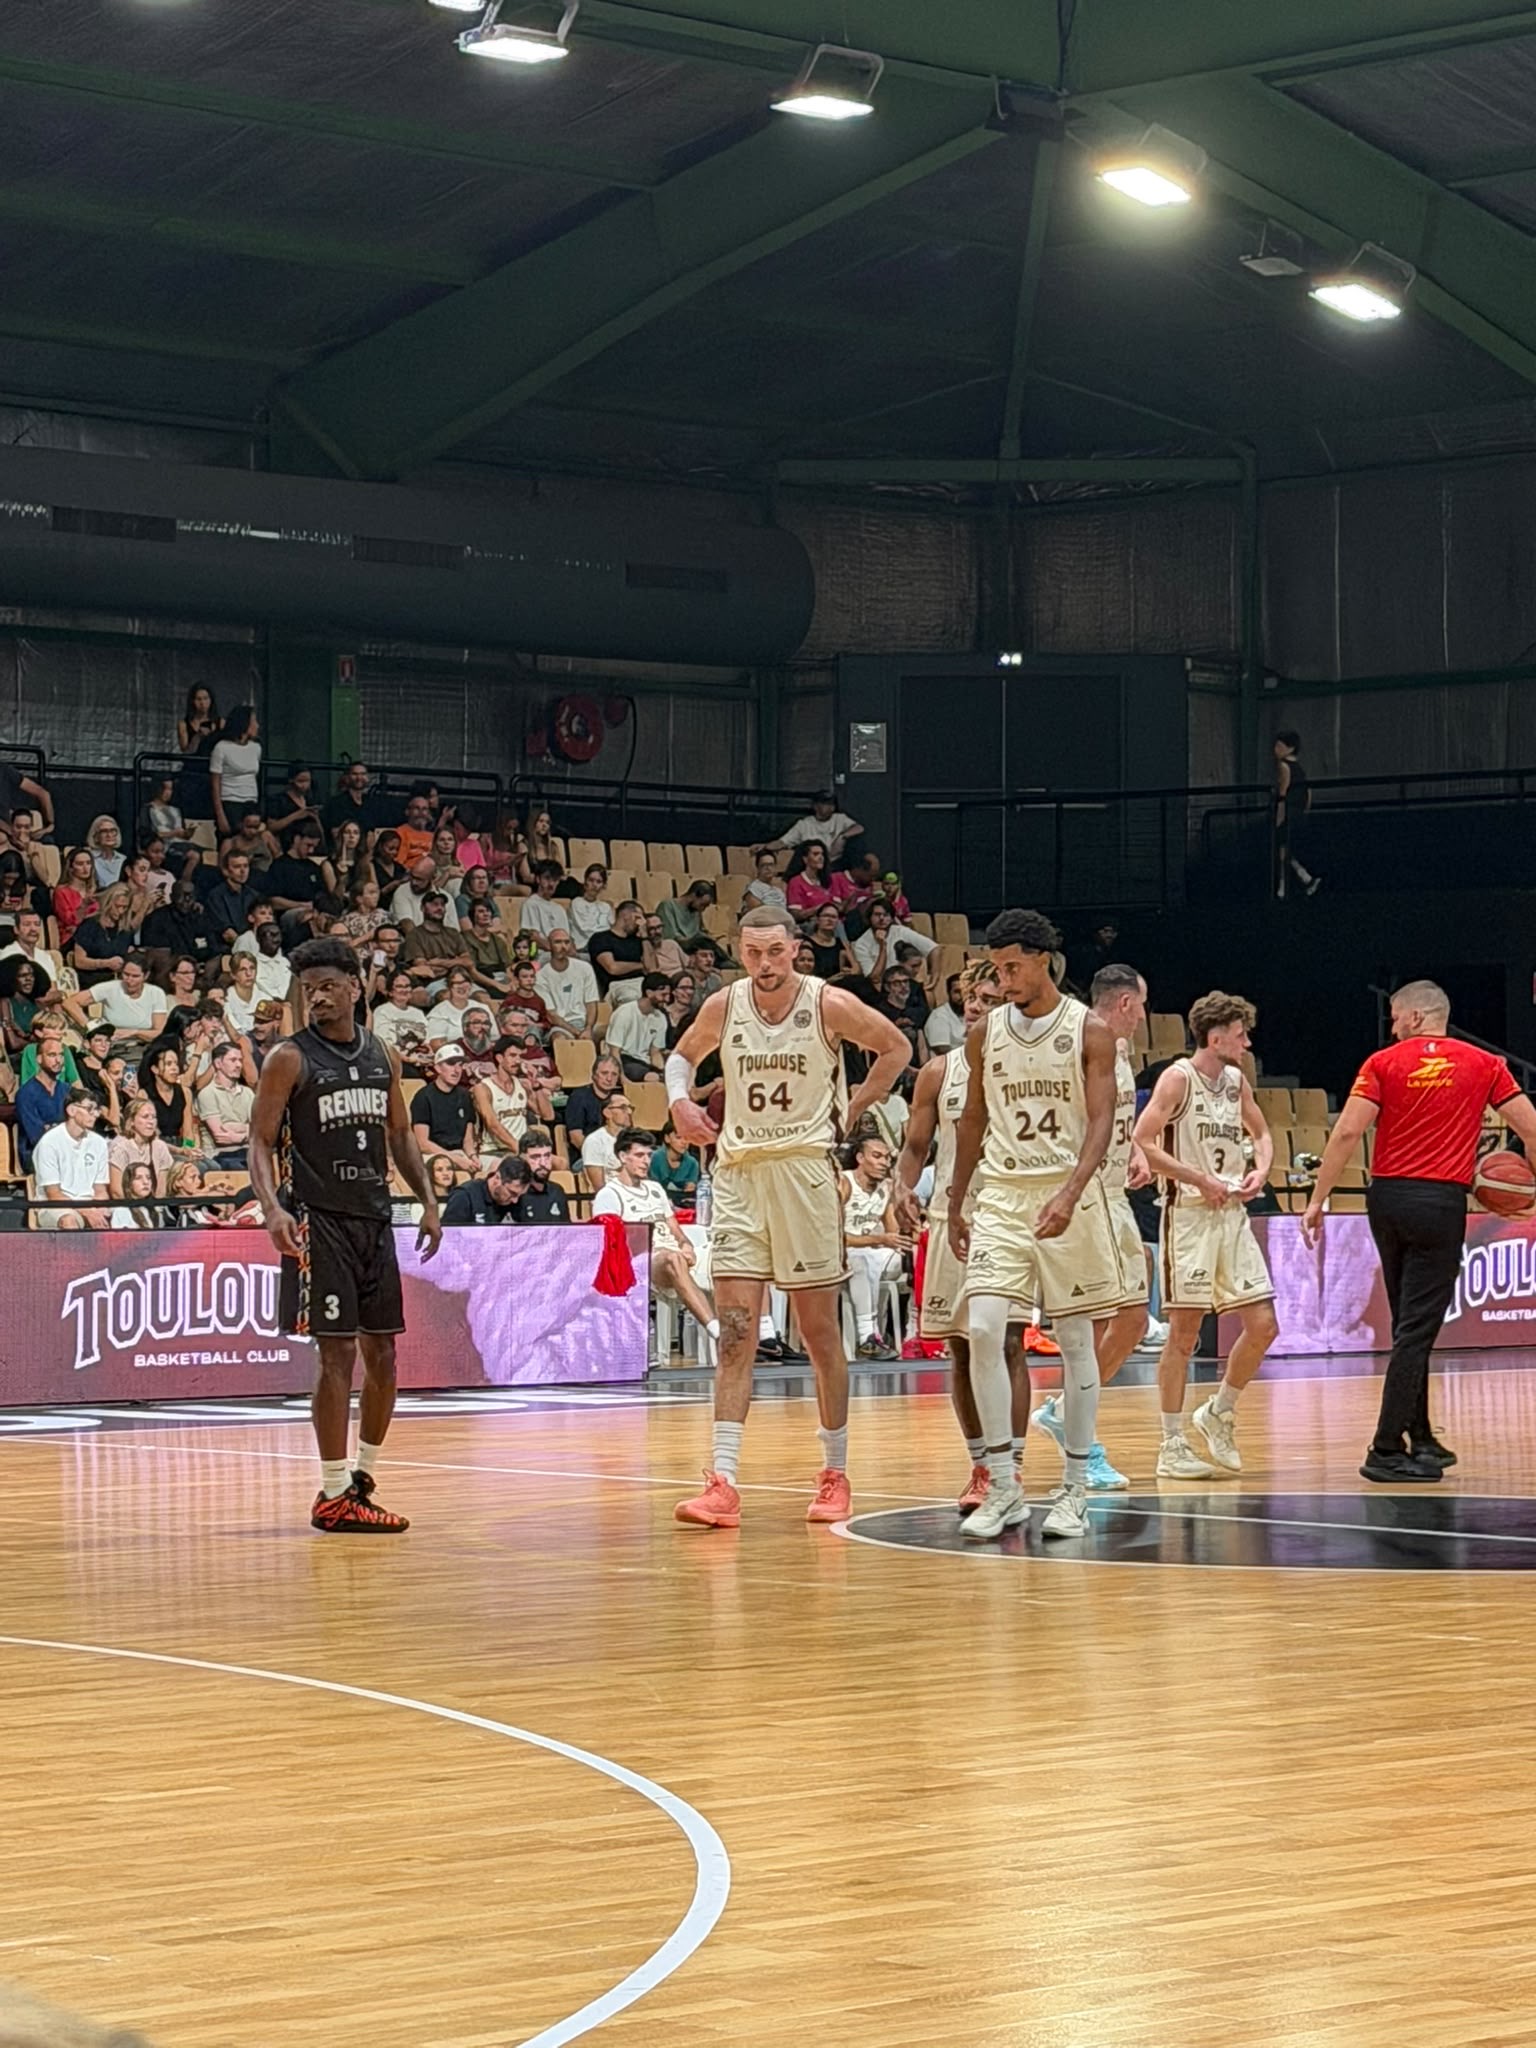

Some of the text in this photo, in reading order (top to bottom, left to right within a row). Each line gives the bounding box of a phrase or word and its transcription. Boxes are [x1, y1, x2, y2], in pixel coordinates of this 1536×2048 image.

[737, 1053, 807, 1078] TOULOUSE
[318, 1088, 388, 1123] RENNES
[747, 1081, 793, 1112] 64
[1002, 1079, 1071, 1107] TOULOUSE
[1015, 1109, 1062, 1142] 24
[356, 1130, 367, 1150] 3
[1213, 1148, 1226, 1174] 3
[61, 1262, 304, 1370] TOULOU
[325, 1294, 340, 1320] 3
[134, 1349, 290, 1368] BASKETBALL CLUB
